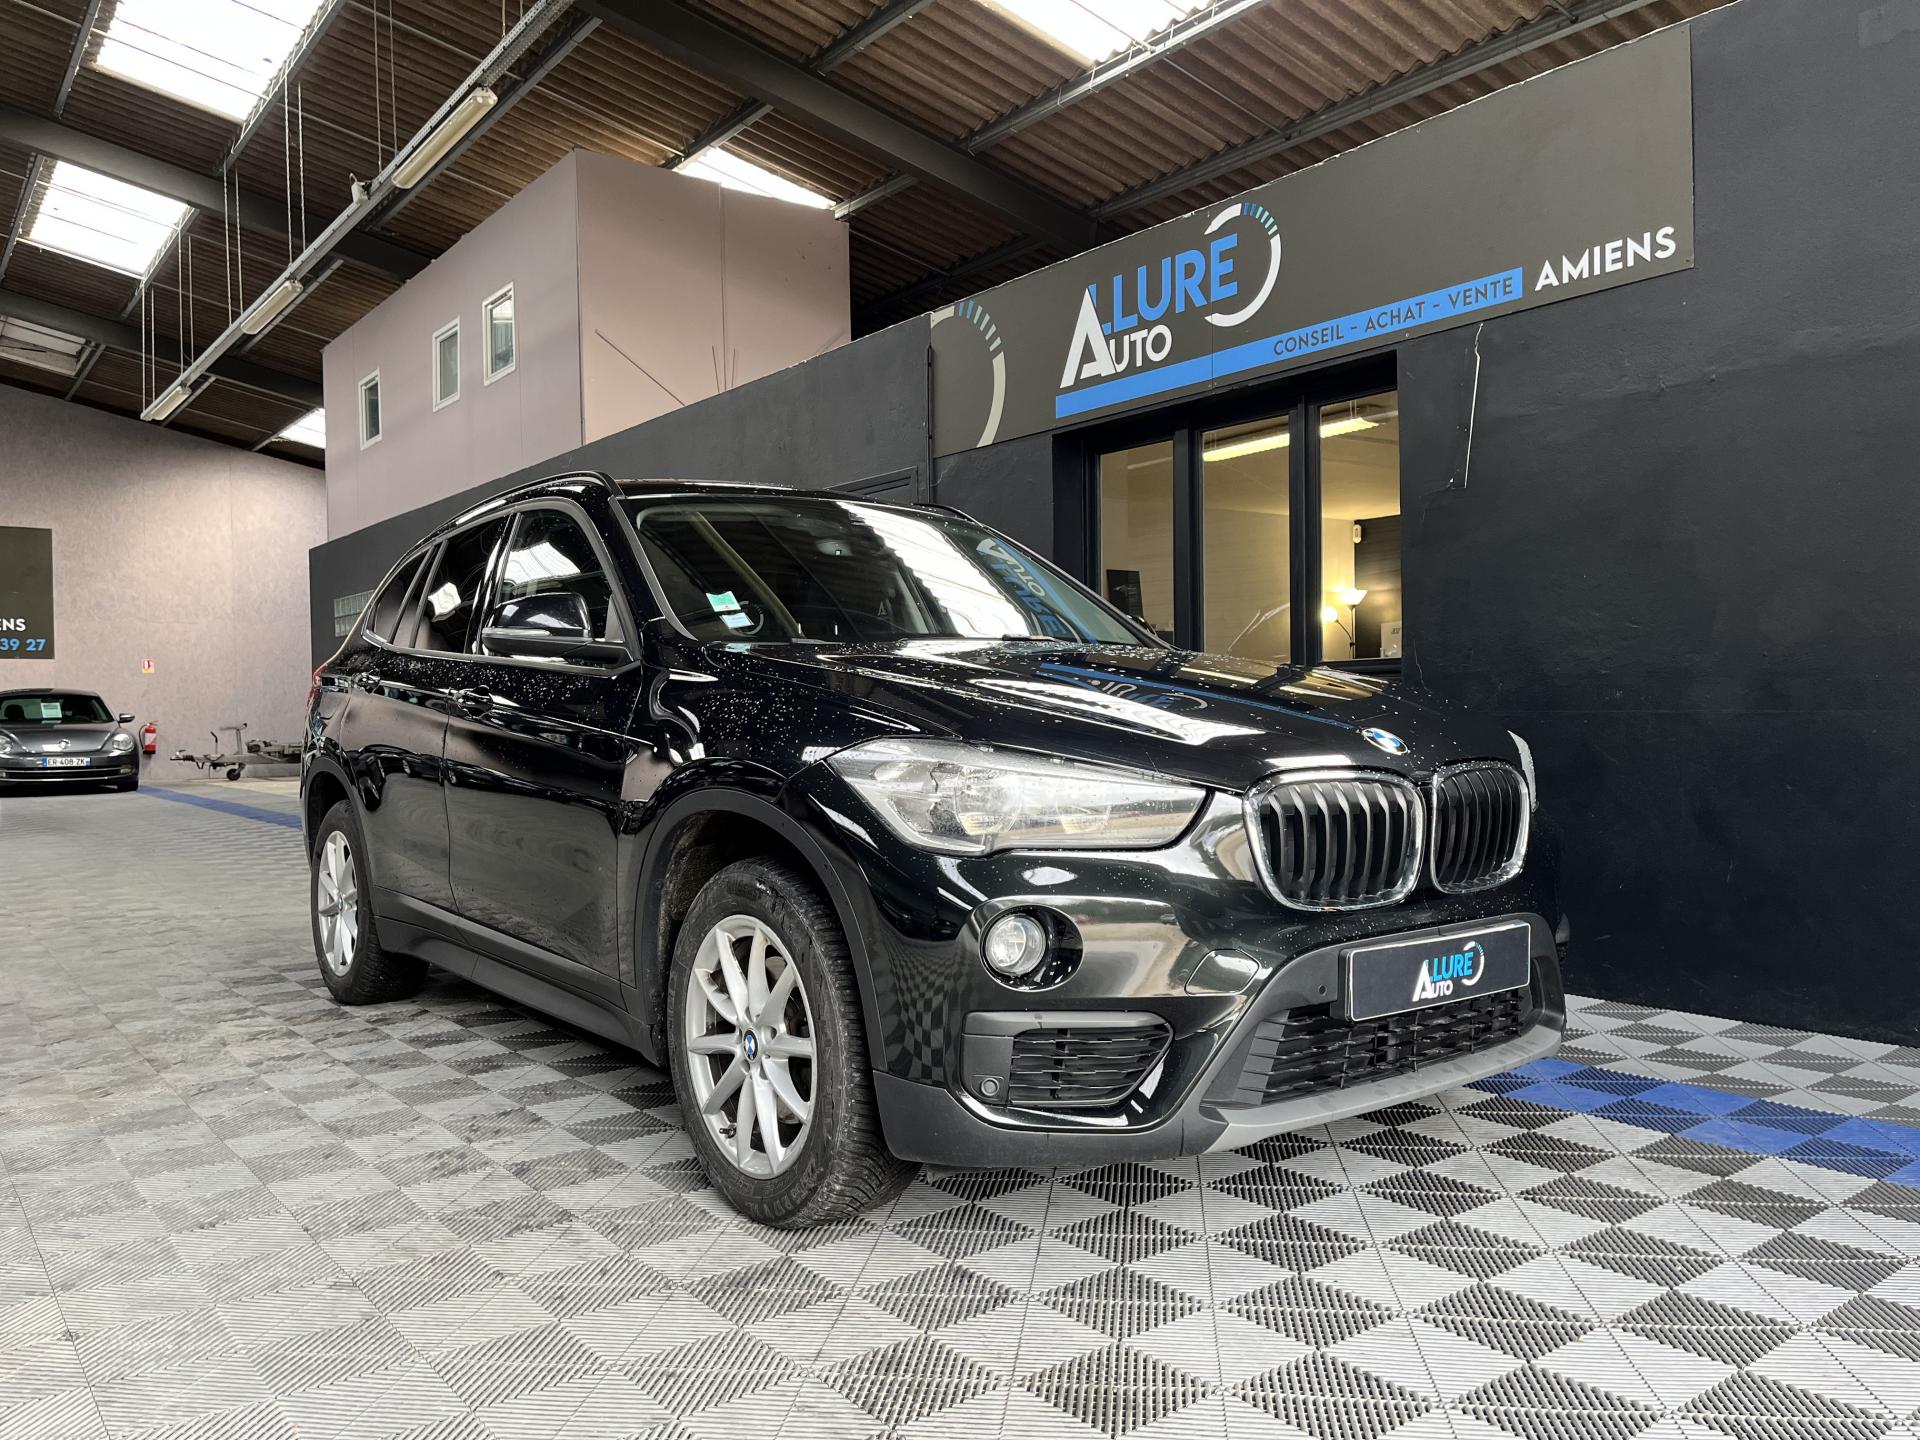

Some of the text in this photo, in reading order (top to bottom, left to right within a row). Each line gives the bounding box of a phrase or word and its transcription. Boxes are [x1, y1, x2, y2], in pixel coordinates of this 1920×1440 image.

[1534, 226, 1677, 291] AMIENS
[1060, 287, 1173, 388] AUTO
[1273, 323, 1345, 356] CONSEIL
[1364, 301, 1426, 332] ACHAT
[1448, 276, 1514, 310] VENTE
[0, 618, 26, 631] NS
[0, 638, 47, 651] 39 27
